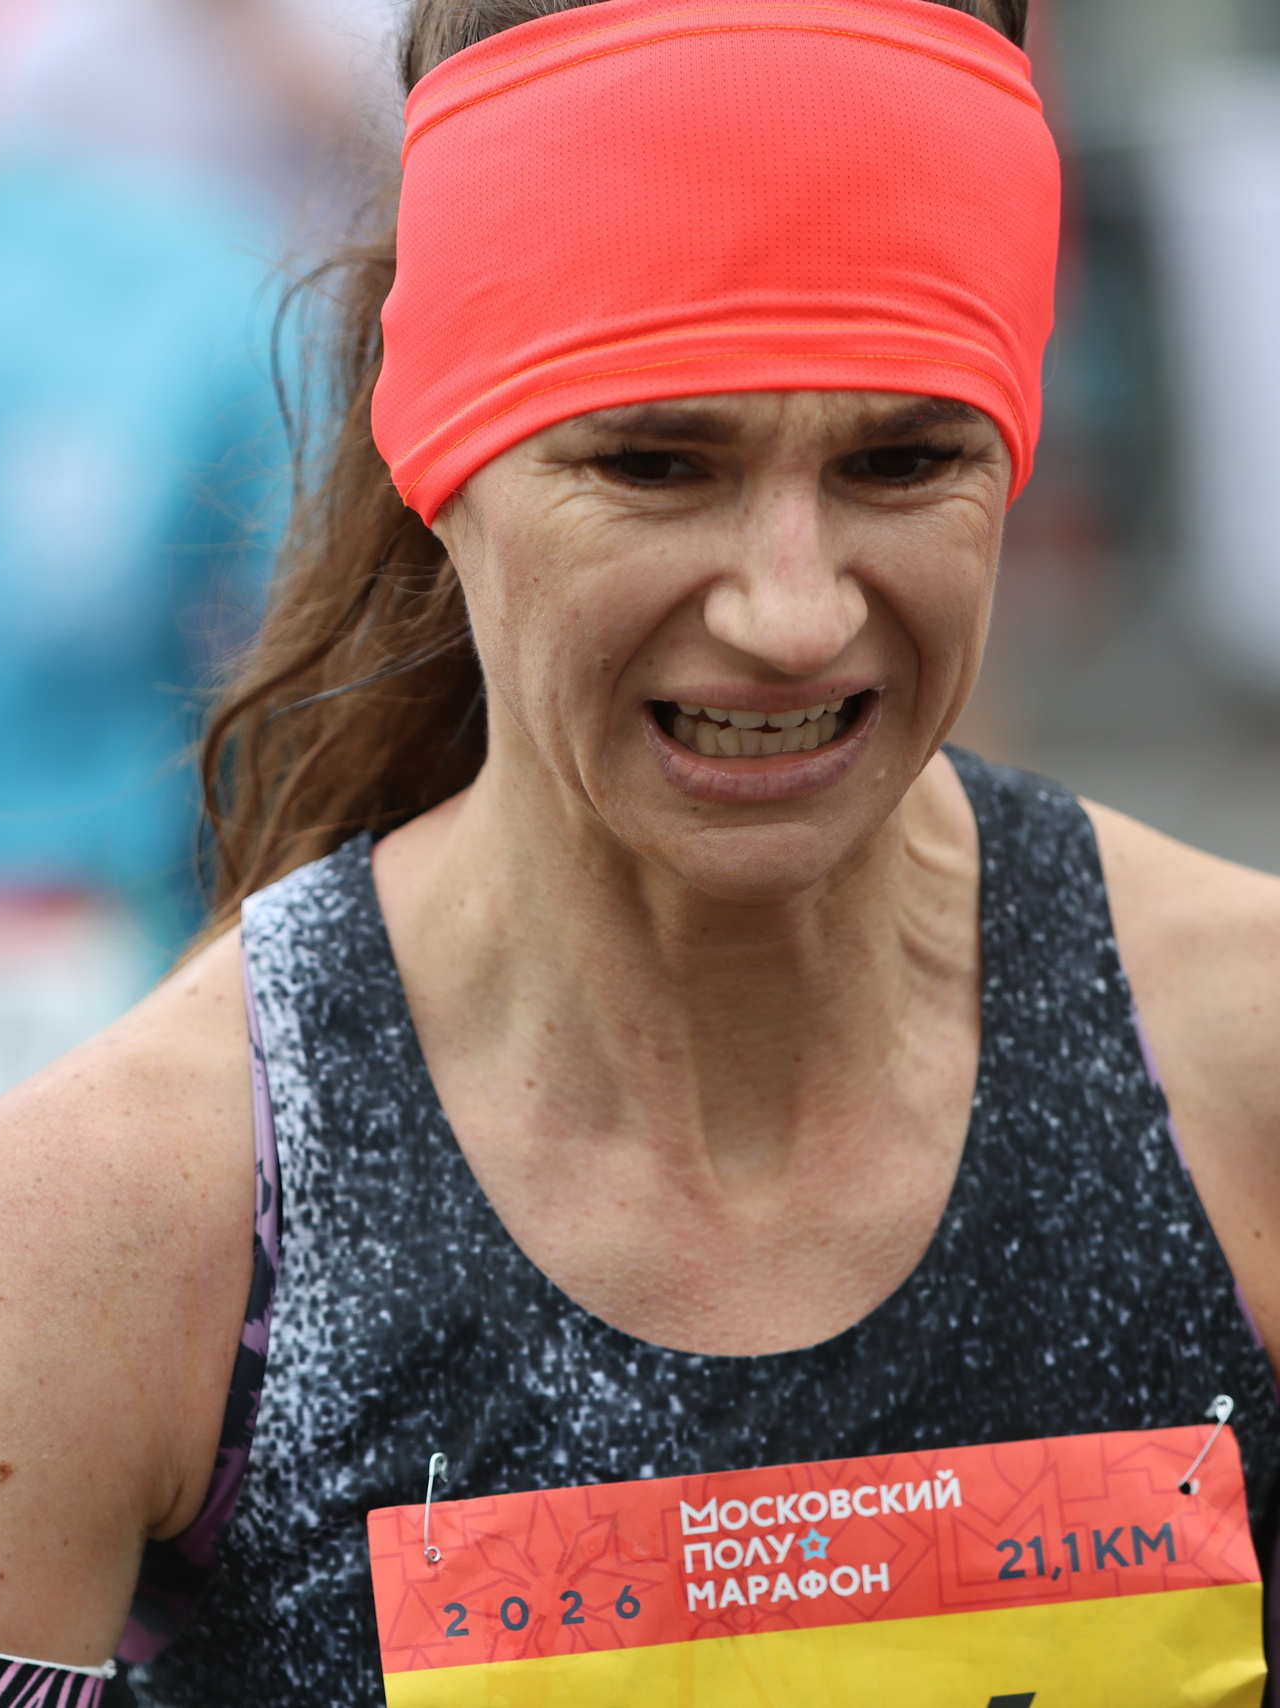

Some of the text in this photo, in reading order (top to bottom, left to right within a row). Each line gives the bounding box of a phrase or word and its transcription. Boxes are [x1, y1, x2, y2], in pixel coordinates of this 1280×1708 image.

[679, 1469, 962, 1535] МОСКОВСКИЙ
[683, 1533, 796, 1573] ПОЛУ
[686, 1562, 890, 1611] МАРАФОН
